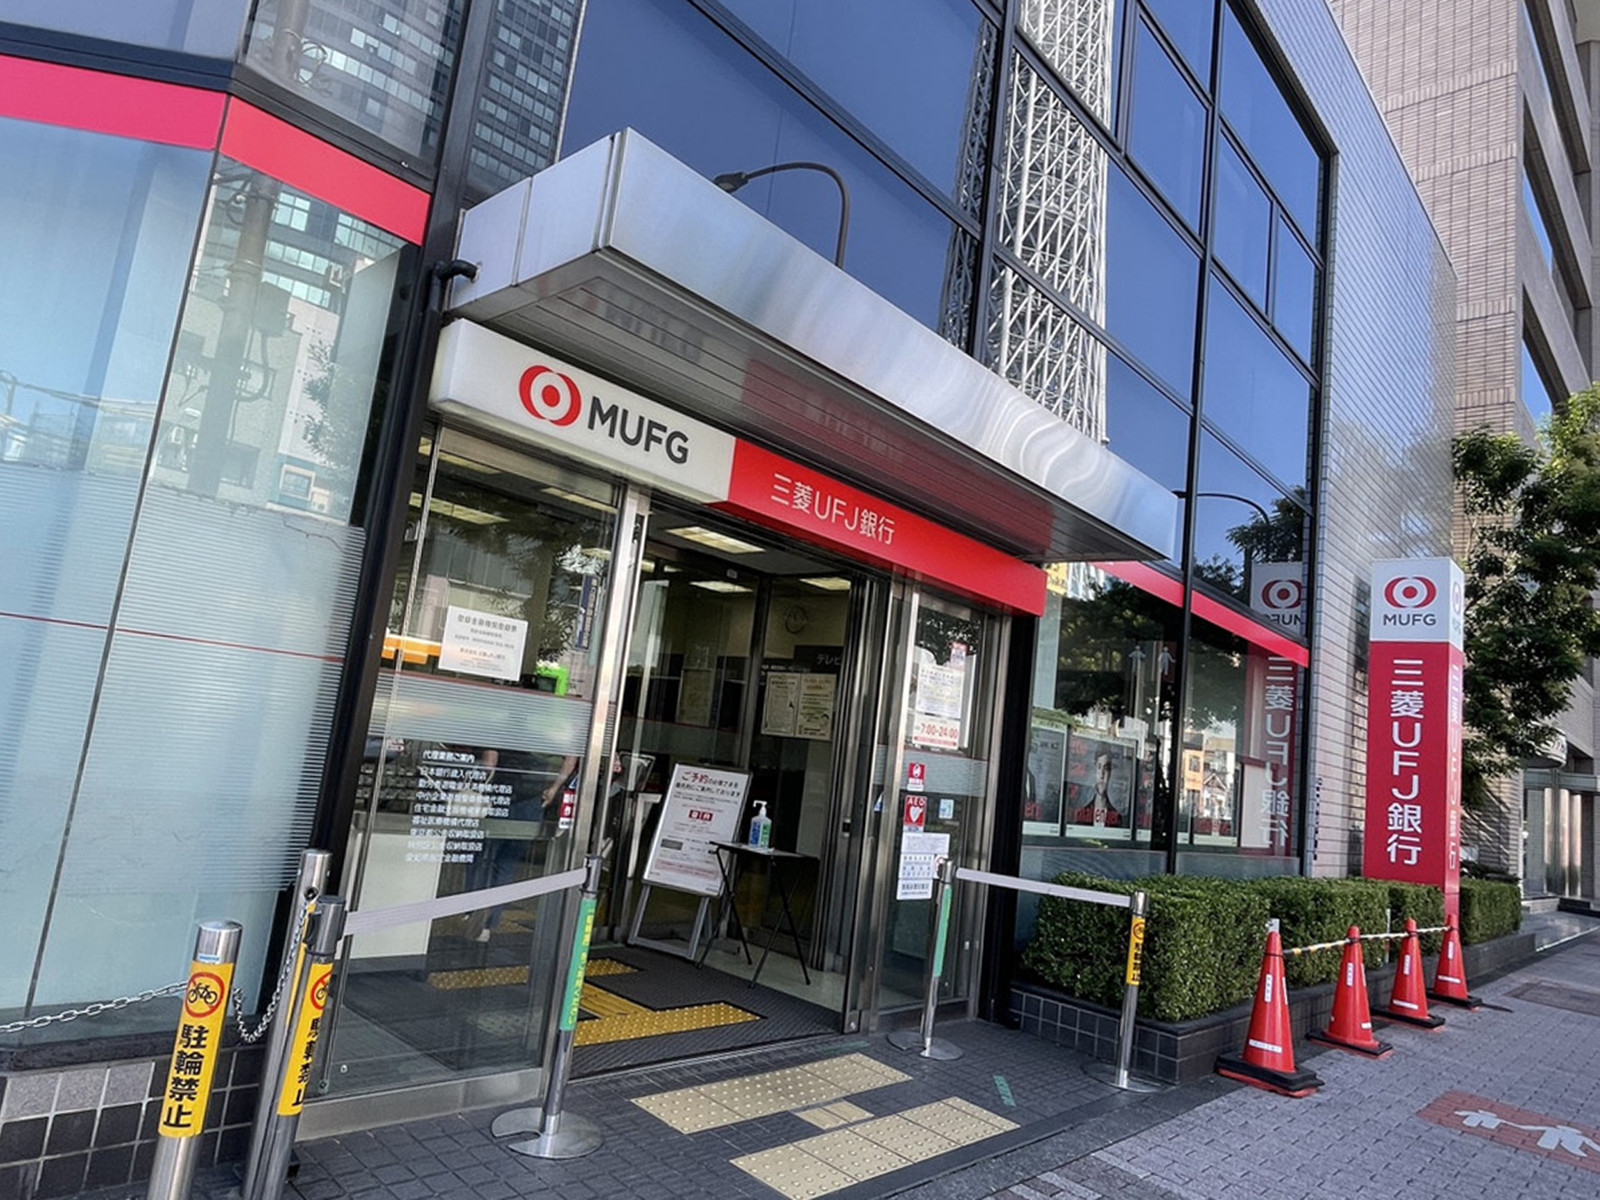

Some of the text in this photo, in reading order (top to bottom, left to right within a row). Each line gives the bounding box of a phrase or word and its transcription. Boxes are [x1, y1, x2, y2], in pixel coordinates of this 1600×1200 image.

[588, 396, 690, 465] MUFG
[769, 472, 896, 545] 三菱UFJ銀行
[1383, 612, 1437, 627] MUFG
[1386, 657, 1425, 867] 三菱UFJ銀行
[163, 1025, 209, 1128] 駐輪禁止
